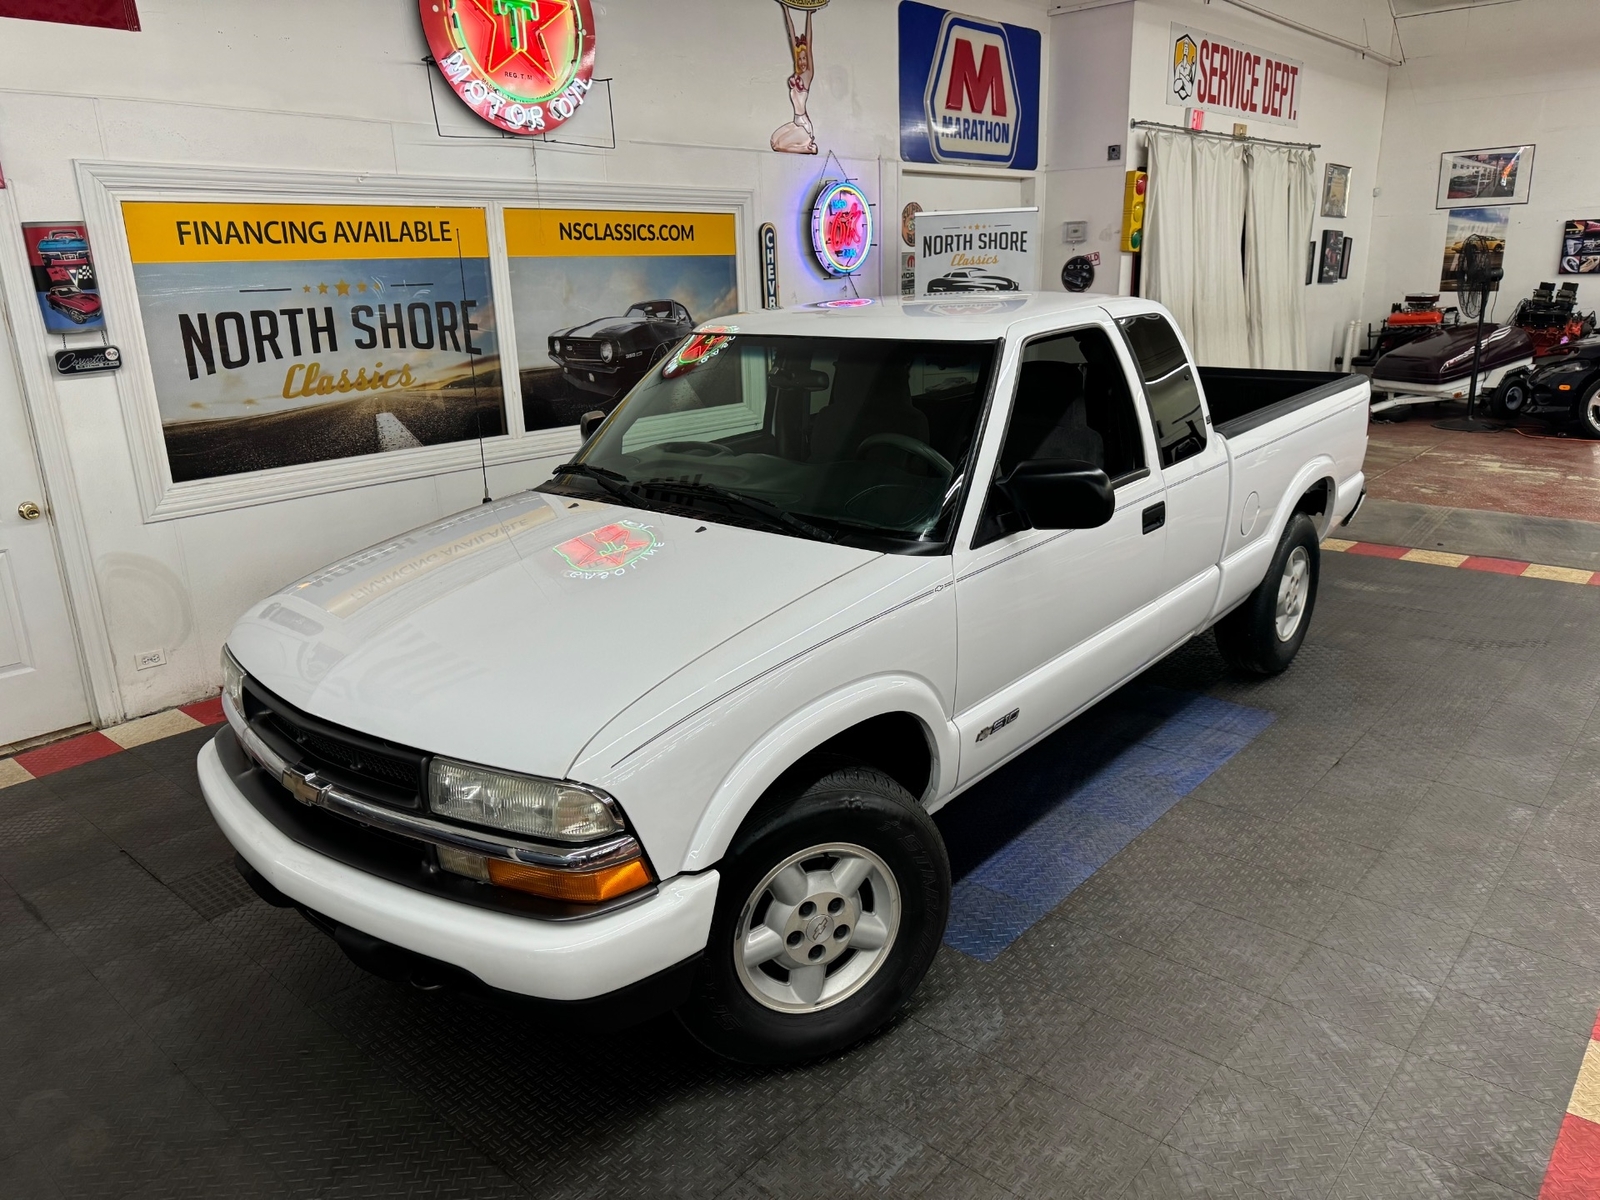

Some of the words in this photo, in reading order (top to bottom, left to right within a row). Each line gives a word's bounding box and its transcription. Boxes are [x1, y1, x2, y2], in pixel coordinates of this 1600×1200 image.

[440, 51, 545, 131] MOTOR
[549, 78, 593, 120] OIL
[945, 38, 1007, 117] M
[1197, 39, 1261, 112] SERVICE
[1262, 58, 1298, 121] DEPT.
[941, 115, 1010, 144] MARATHON
[176, 220, 327, 245] FINANCING
[333, 221, 452, 243] AVAILABLE
[559, 222, 695, 242] NSCLASSICS.COM
[923, 234, 973, 258] NORTH
[978, 231, 1028, 253] SHORE
[950, 253, 999, 267] Classics
[178, 306, 338, 381] NORTH
[350, 300, 483, 356] SHORE
[282, 362, 417, 399] Classics
[989, 707, 1020, 735] S10
